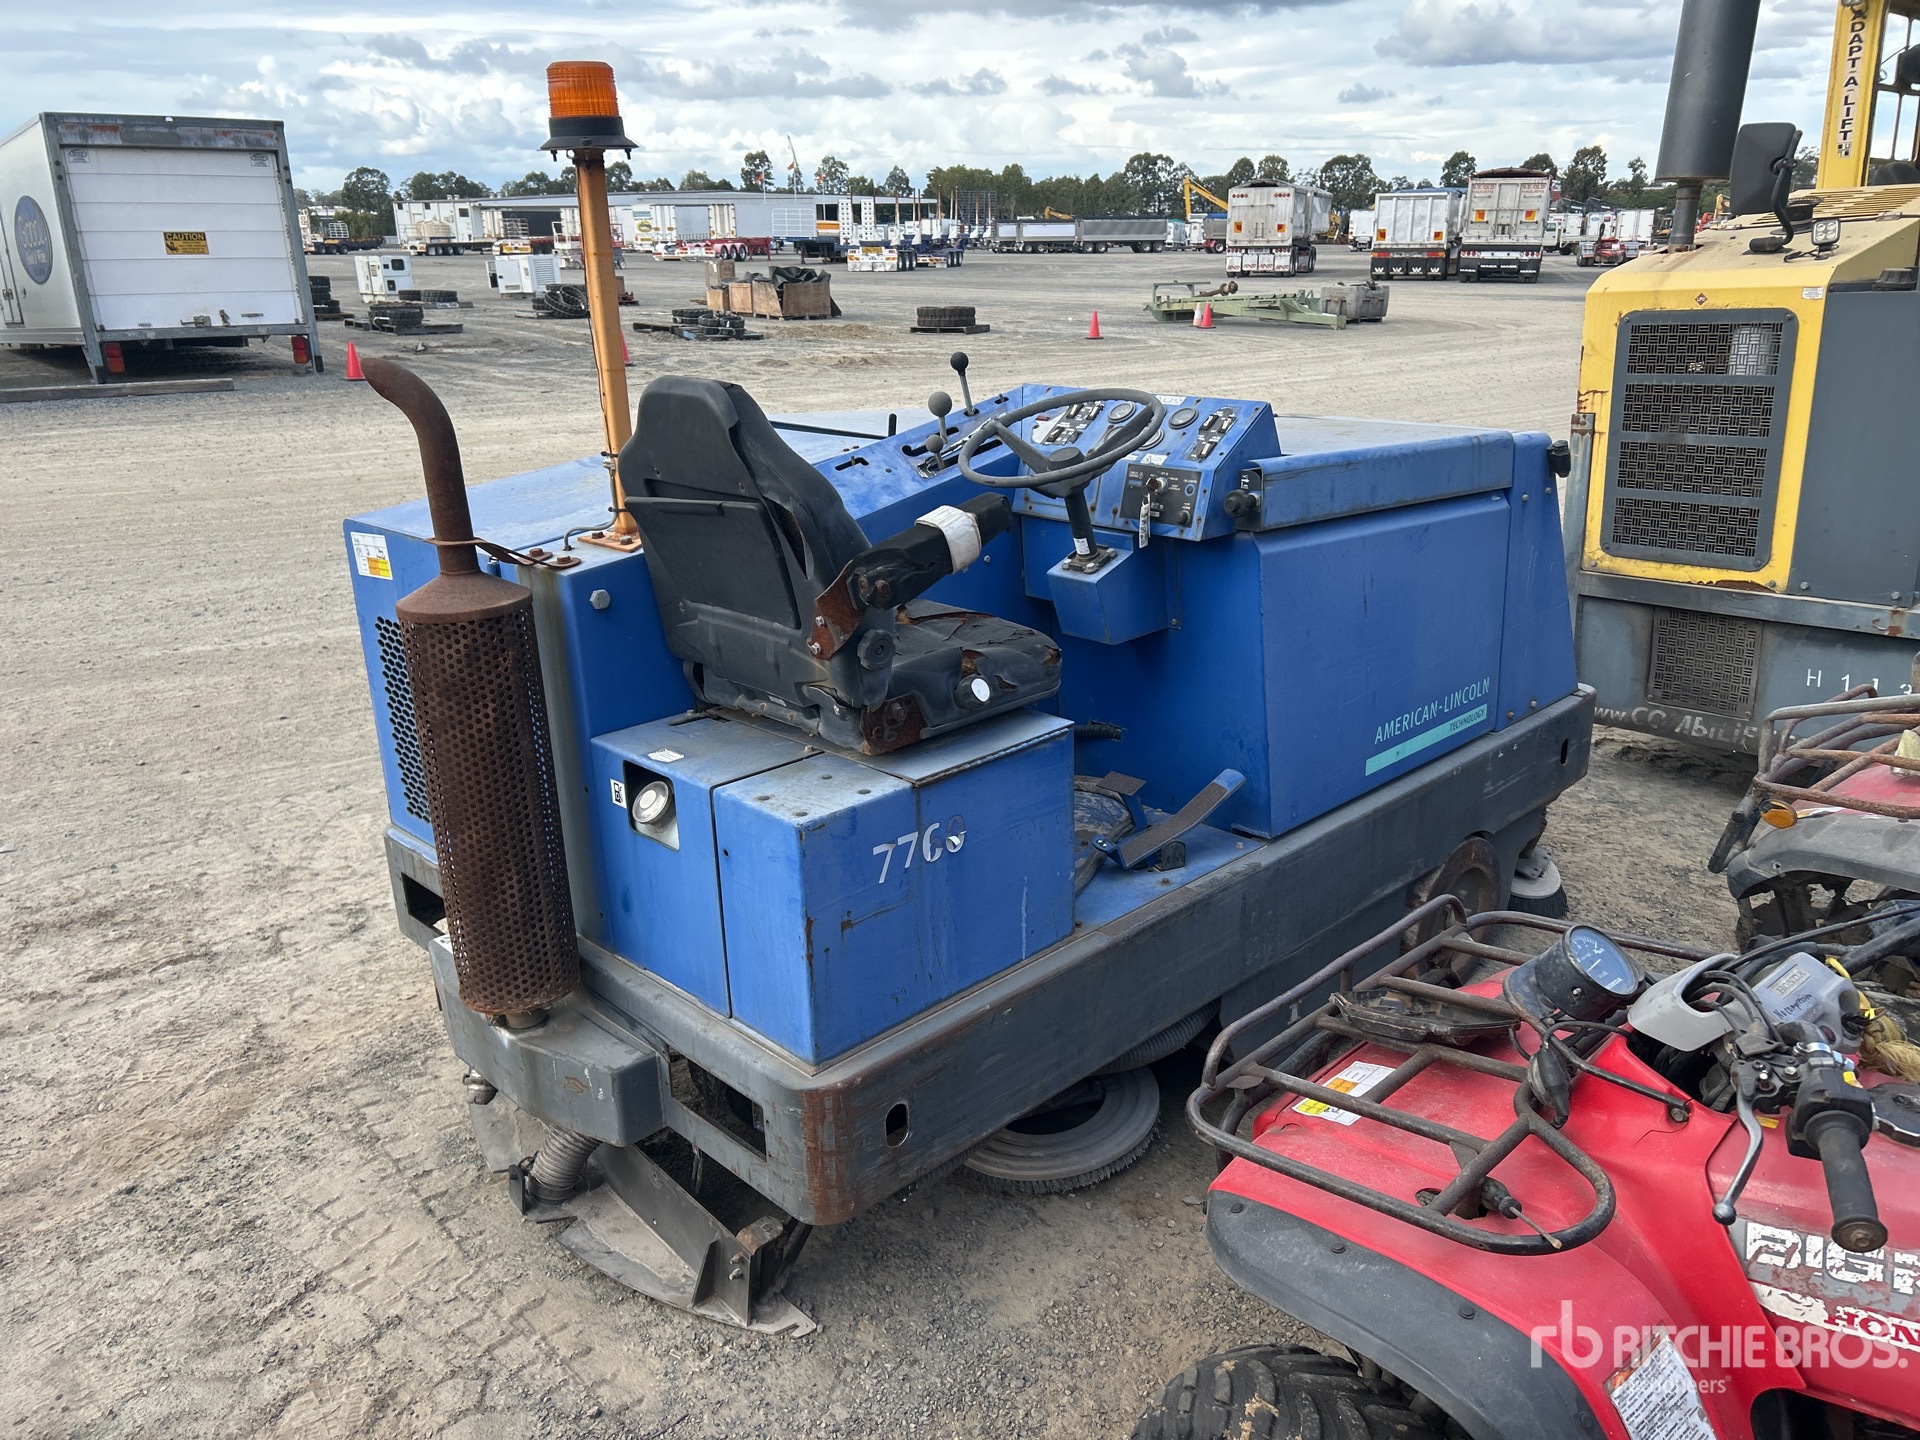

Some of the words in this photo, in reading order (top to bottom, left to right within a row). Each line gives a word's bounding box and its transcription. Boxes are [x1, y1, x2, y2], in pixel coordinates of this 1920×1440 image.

[1374, 677, 1490, 744] AMERICAN-LINCOLN
[1449, 709, 1484, 732] TECHNOLOGY
[1776, 968, 1808, 994] HONDA
